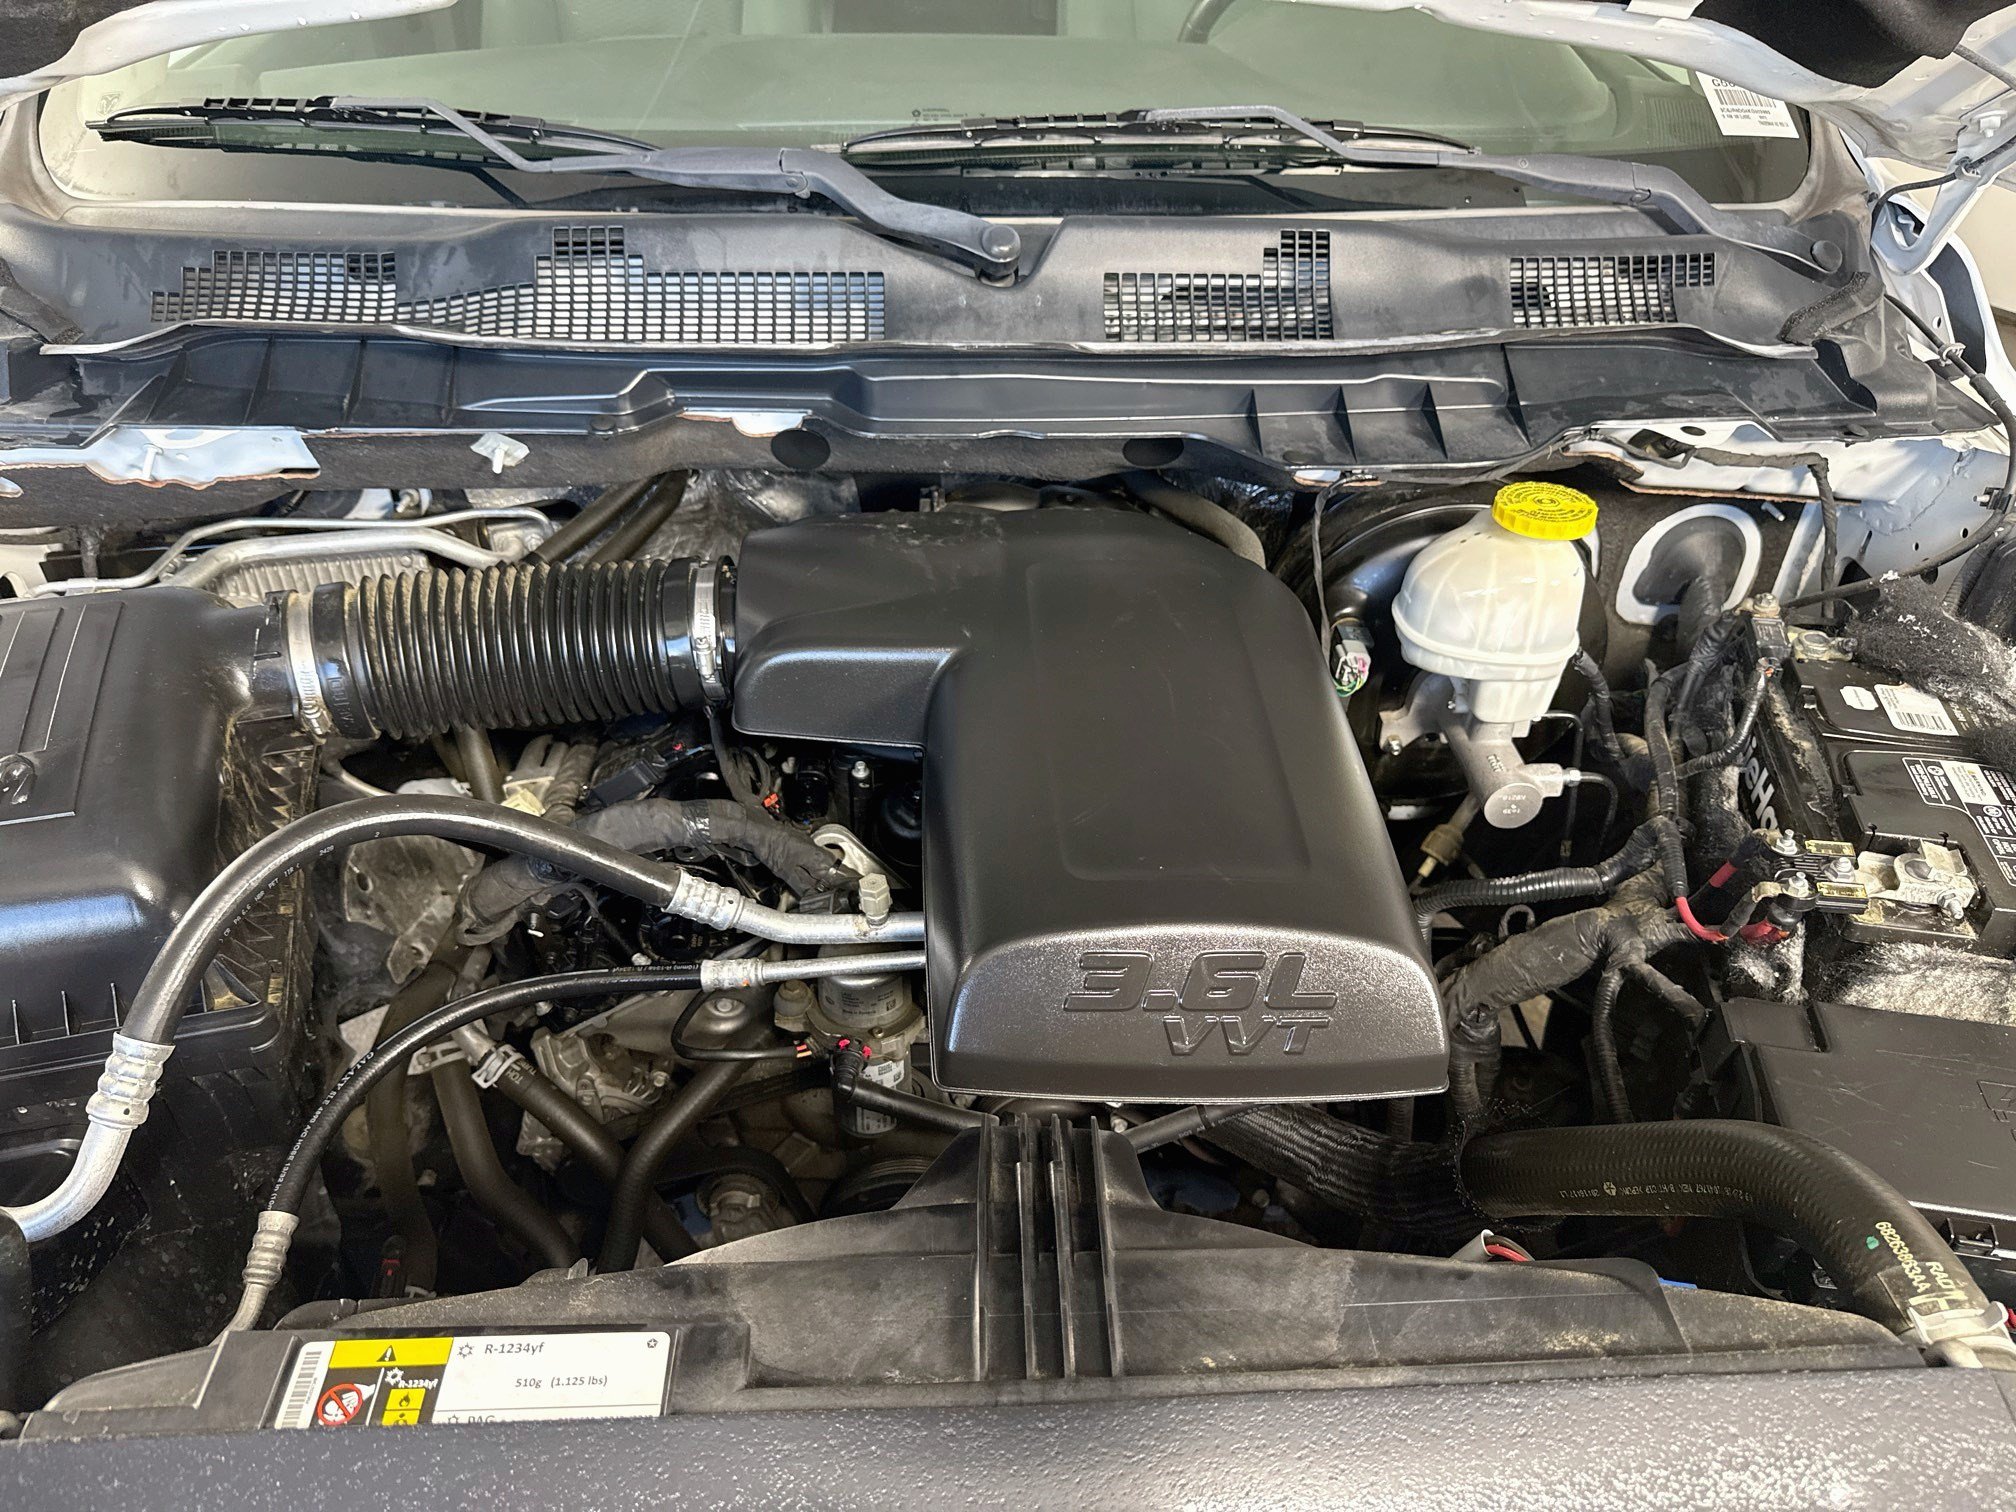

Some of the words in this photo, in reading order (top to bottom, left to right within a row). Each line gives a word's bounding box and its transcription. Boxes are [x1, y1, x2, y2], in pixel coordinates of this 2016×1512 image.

[1062, 949, 1339, 1012] 3.6L
[1162, 1015, 1334, 1056] VVT
[337, 1051, 375, 1091] GALAXY
[288, 1139, 304, 1161] HOSE
[1875, 1221, 1931, 1293] 68263863AA
[484, 1341, 546, 1355] R-1234yf
[398, 1377, 438, 1390] R-1234yf
[515, 1377, 542, 1389] 510g
[550, 1376, 585, 1388] (1.125
[588, 1375, 608, 1387] lbs)
